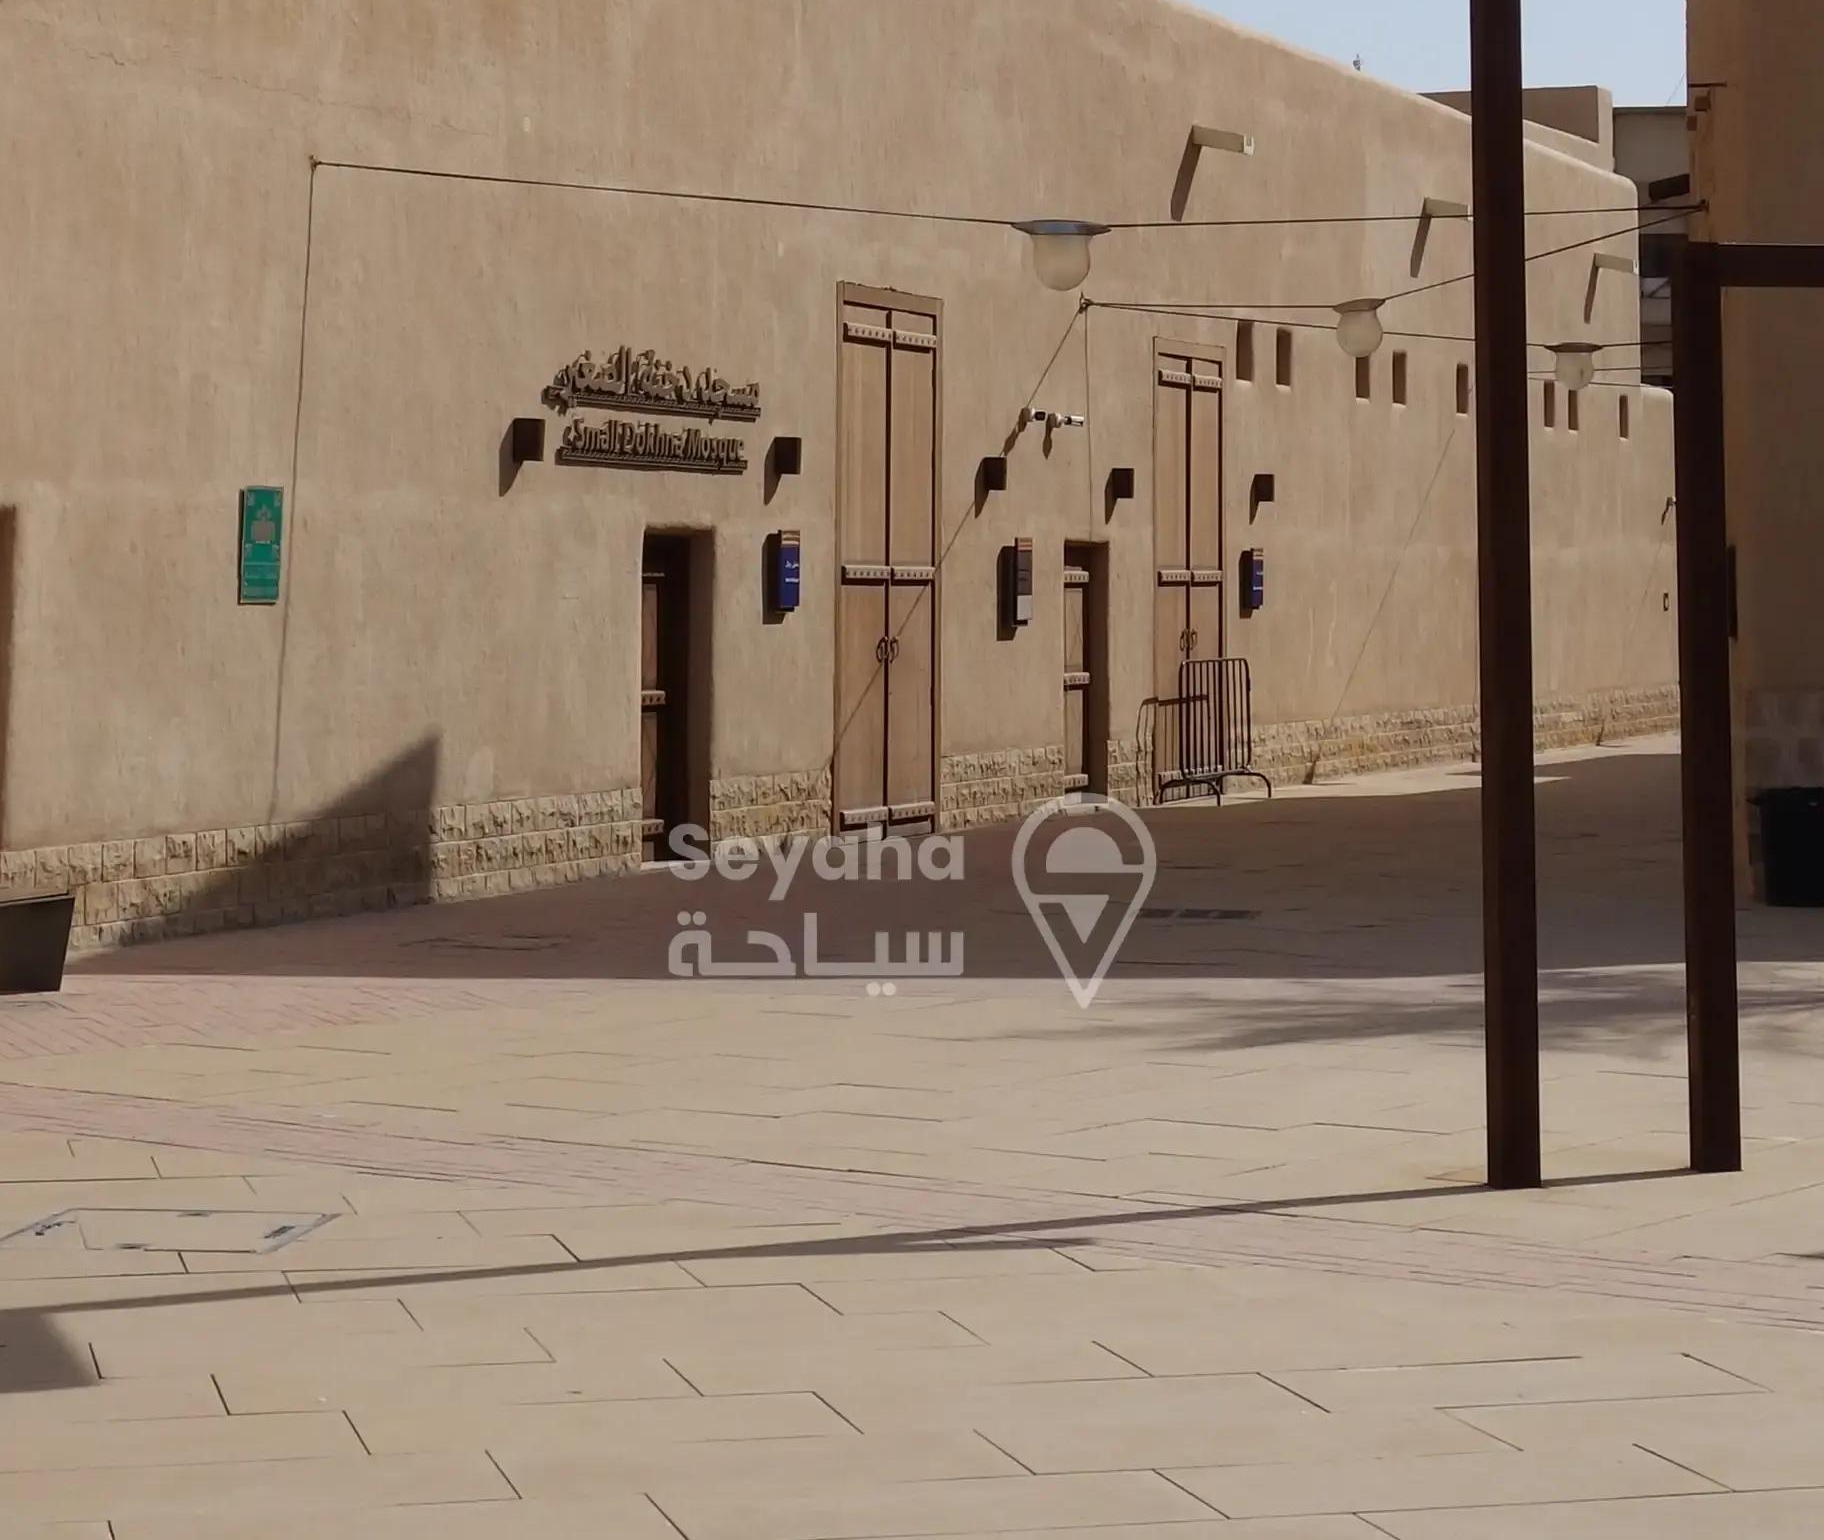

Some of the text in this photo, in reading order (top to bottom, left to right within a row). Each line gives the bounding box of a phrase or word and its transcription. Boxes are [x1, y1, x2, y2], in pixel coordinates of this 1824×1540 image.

[567, 417, 745, 464] Small Dokhna Mosque
